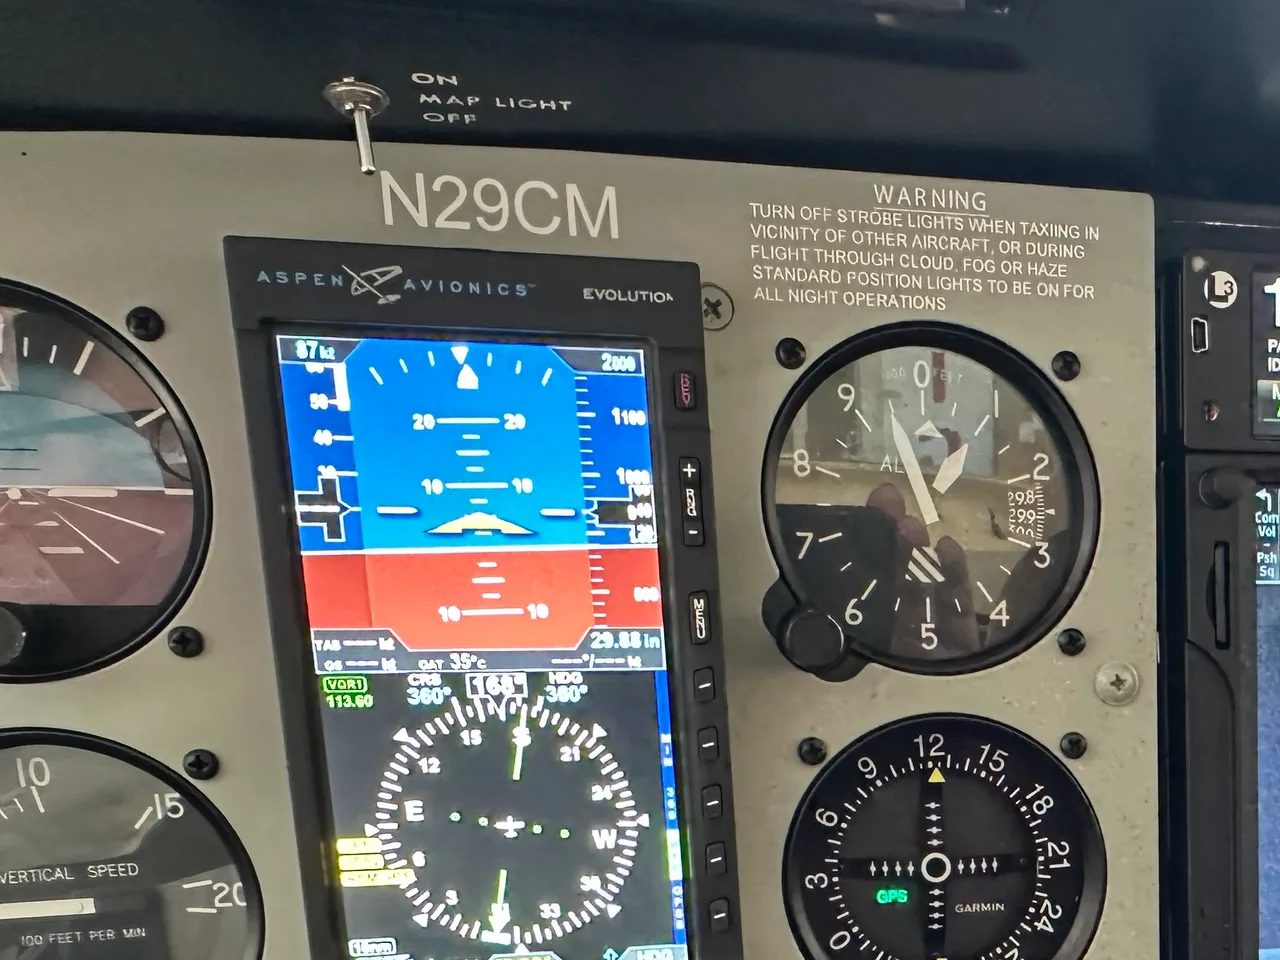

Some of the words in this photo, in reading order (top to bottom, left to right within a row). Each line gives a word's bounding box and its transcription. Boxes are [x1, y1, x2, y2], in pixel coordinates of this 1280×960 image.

[411, 73, 458, 86] ON
[419, 93, 480, 106] MAP
[495, 97, 572, 112] LIGHT
[423, 112, 477, 124] OFF
[379, 171, 620, 240] N29CM
[874, 184, 988, 212] WARNING
[749, 203, 795, 220] TURN
[801, 207, 833, 222] OFF
[837, 209, 903, 228] STROBE
[907, 213, 964, 232] LIGHTS
[969, 217, 1016, 235] WHEN
[1020, 221, 1081, 239] TAXIING
[1085, 226, 1100, 241] IN
[750, 224, 820, 242] VICINITY
[825, 229, 847, 243] OF
[852, 231, 908, 248] OTHER
[912, 234, 995, 255] AIRCRAFT,
[999, 240, 1021, 256] OR
[1025, 242, 1086, 260] DURING
[750, 245, 809, 262] FLIGHT
[814, 248, 895, 268] THROUGH
[963, 258, 996, 274] FOG
[1001, 260, 1023, 276] OR
[1028, 262, 1068, 279] HAZE
[257, 271, 344, 288] ASPEN
[753, 265, 842, 284] STANDARD
[847, 271, 923, 290] POSITION
[928, 275, 983, 293] LIGHTS
[988, 280, 1008, 294] TO
[1012, 280, 1032, 296] BE
[1037, 282, 1060, 297] ON
[1064, 284, 1095, 299] FOR
[754, 287, 784, 301] ALL
[788, 289, 839, 305] NIGHT
[843, 291, 946, 311] OPERATIONS
[694, 598, 707, 639] MENU
[407, 673, 442, 688] CRS
[548, 671, 584, 686] HDG
[913, 733, 945, 758] 12
[977, 743, 1009, 773] 15
[15, 756, 52, 789] 10
[152, 793, 186, 820] 15
[404, 800, 424, 822] E
[1025, 783, 1055, 817] 18
[592, 830, 618, 850] W
[1047, 840, 1071, 871] 21
[0, 867, 75, 885] VERTICAL
[87, 862, 139, 879] SPEED
[876, 889, 908, 903] GPS
[955, 902, 1005, 913] GARMIN
[1034, 898, 1063, 934] 24
[21, 934, 43, 947] 100
[48, 931, 83, 945] FEET
[89, 929, 116, 942] PER
